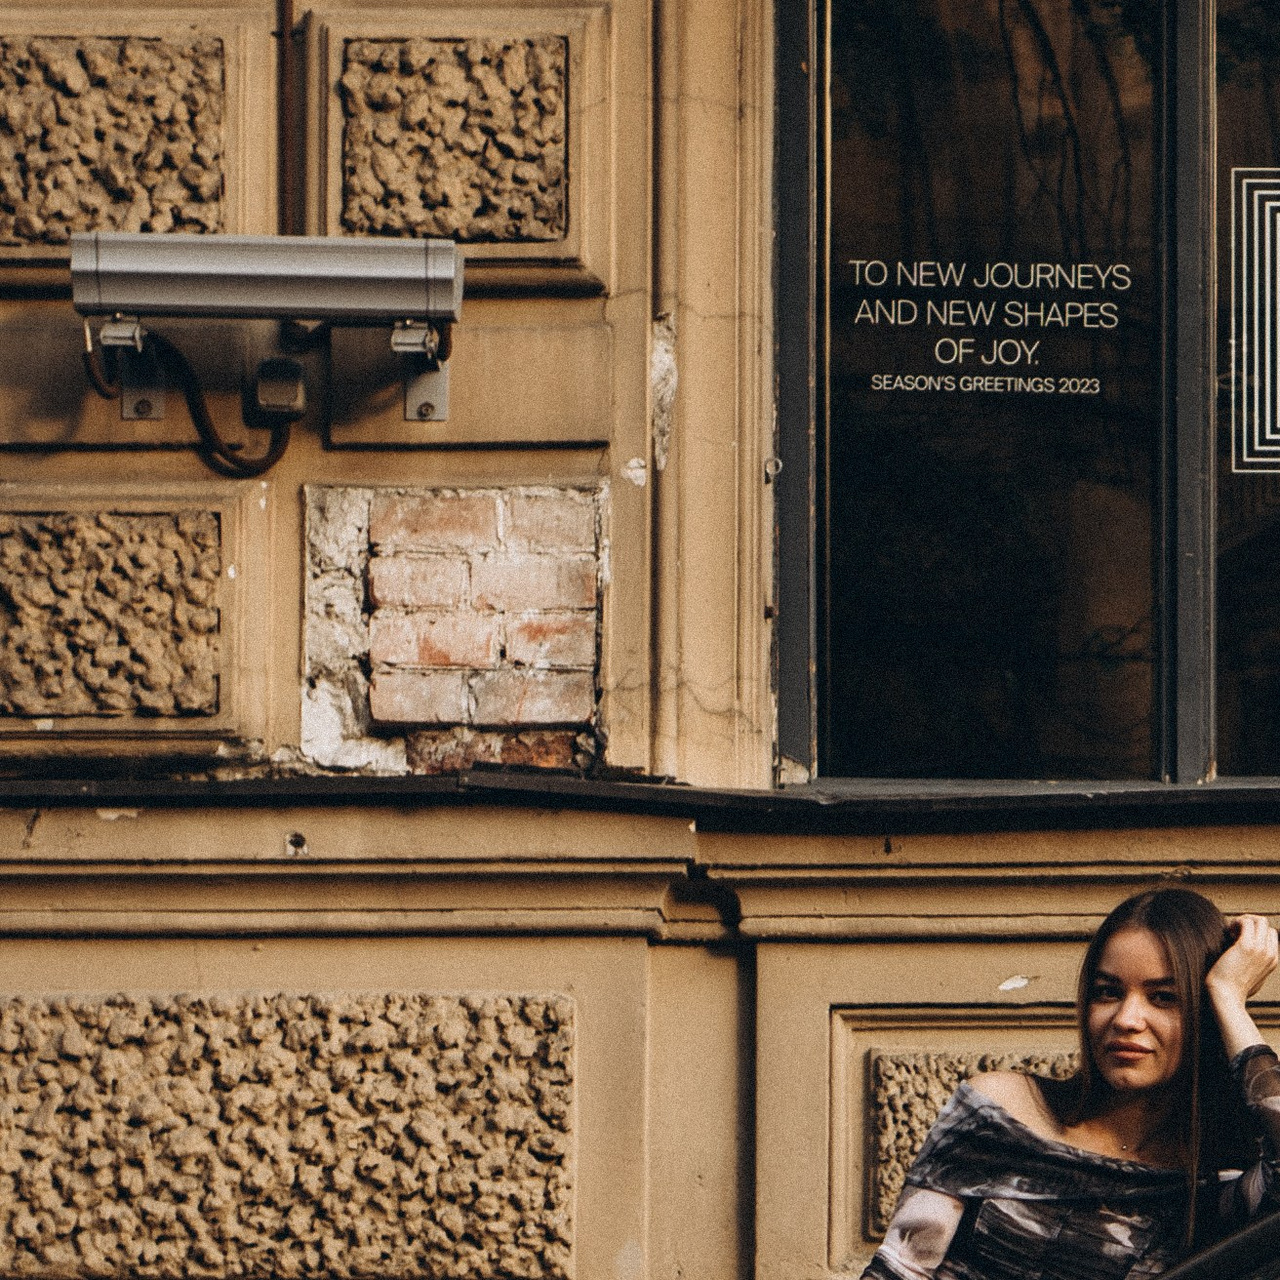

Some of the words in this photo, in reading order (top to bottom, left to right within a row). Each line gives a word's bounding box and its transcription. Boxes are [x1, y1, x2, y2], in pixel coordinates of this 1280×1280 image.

[848, 259, 888, 286] TO
[896, 261, 967, 287] NEW
[973, 262, 1132, 291] JOURNEYS
[854, 298, 918, 325] AND
[926, 300, 997, 326] NEW
[1003, 301, 1119, 329] SHAPES
[934, 337, 976, 365] OF
[980, 338, 1041, 366] JOY.
[870, 374, 957, 392] SEASON'S
[959, 376, 1056, 393] GREETINGS
[1058, 378, 1101, 394] 2023
